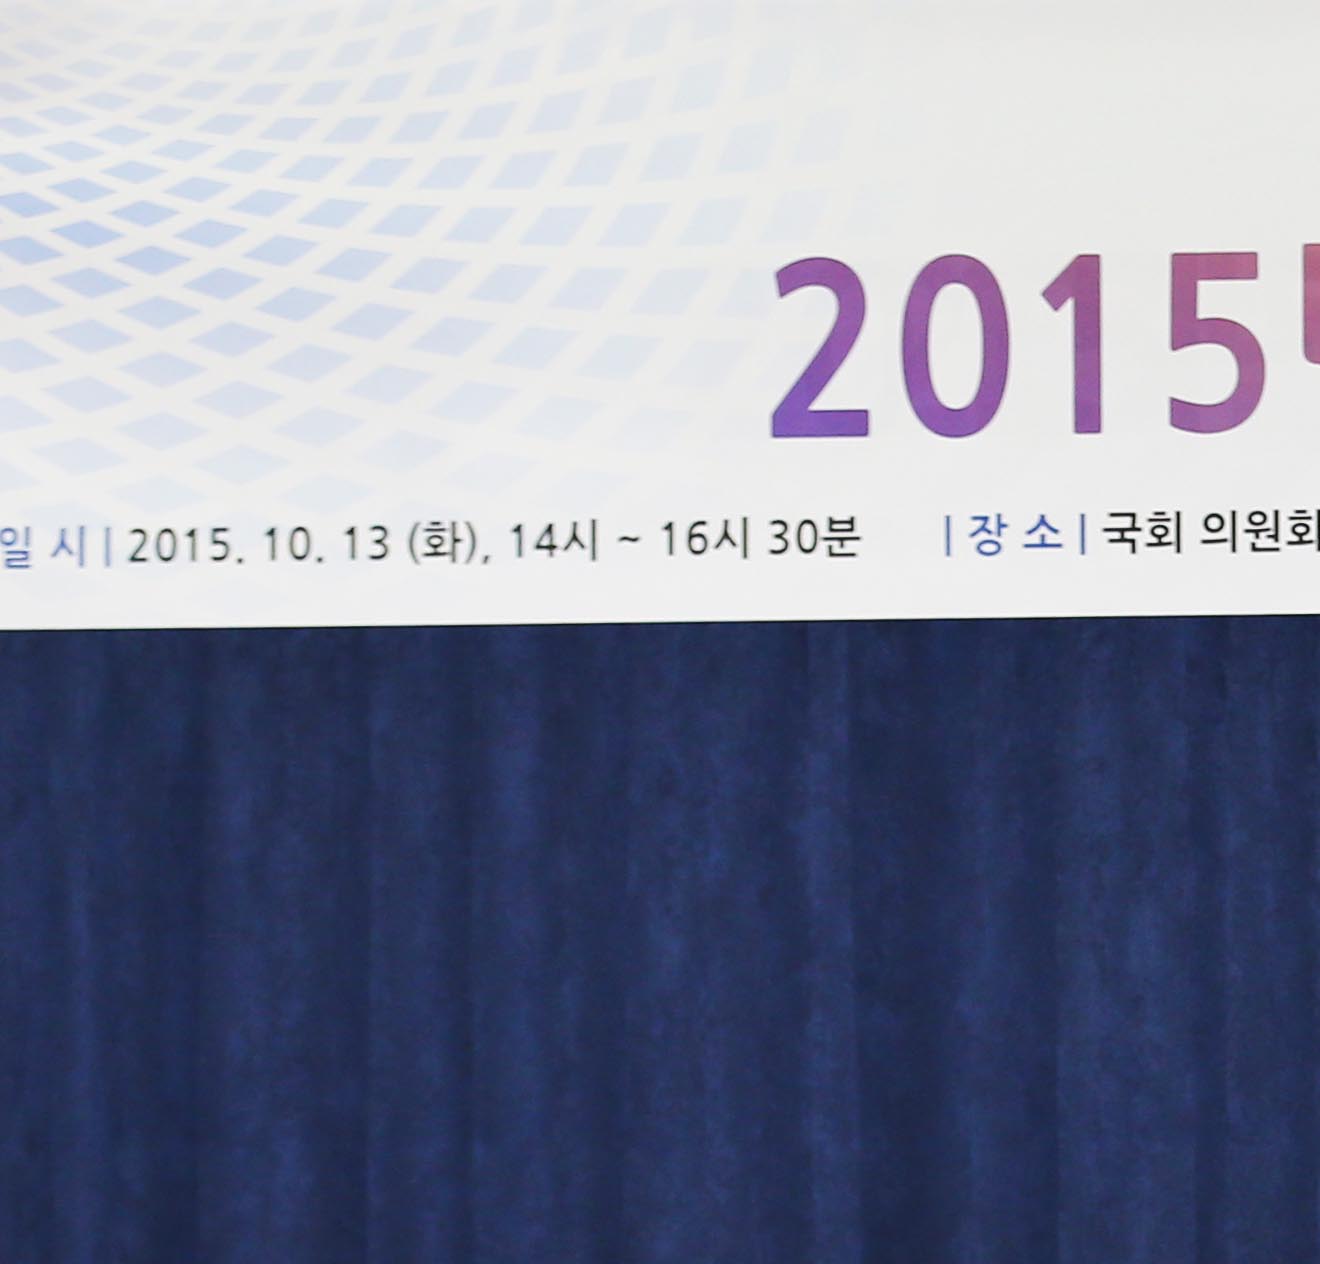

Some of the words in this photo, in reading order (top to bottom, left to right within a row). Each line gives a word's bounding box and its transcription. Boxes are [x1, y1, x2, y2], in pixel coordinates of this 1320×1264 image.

[128, 527, 244, 564] 2015.
[265, 526, 324, 563] 10.
[345, 525, 389, 561] 13
[409, 521, 490, 564] (화),
[511, 518, 597, 561] 14시
[662, 516, 748, 560] 16시
[769, 515, 862, 558] 30분
[1101, 510, 1182, 555] 국회
